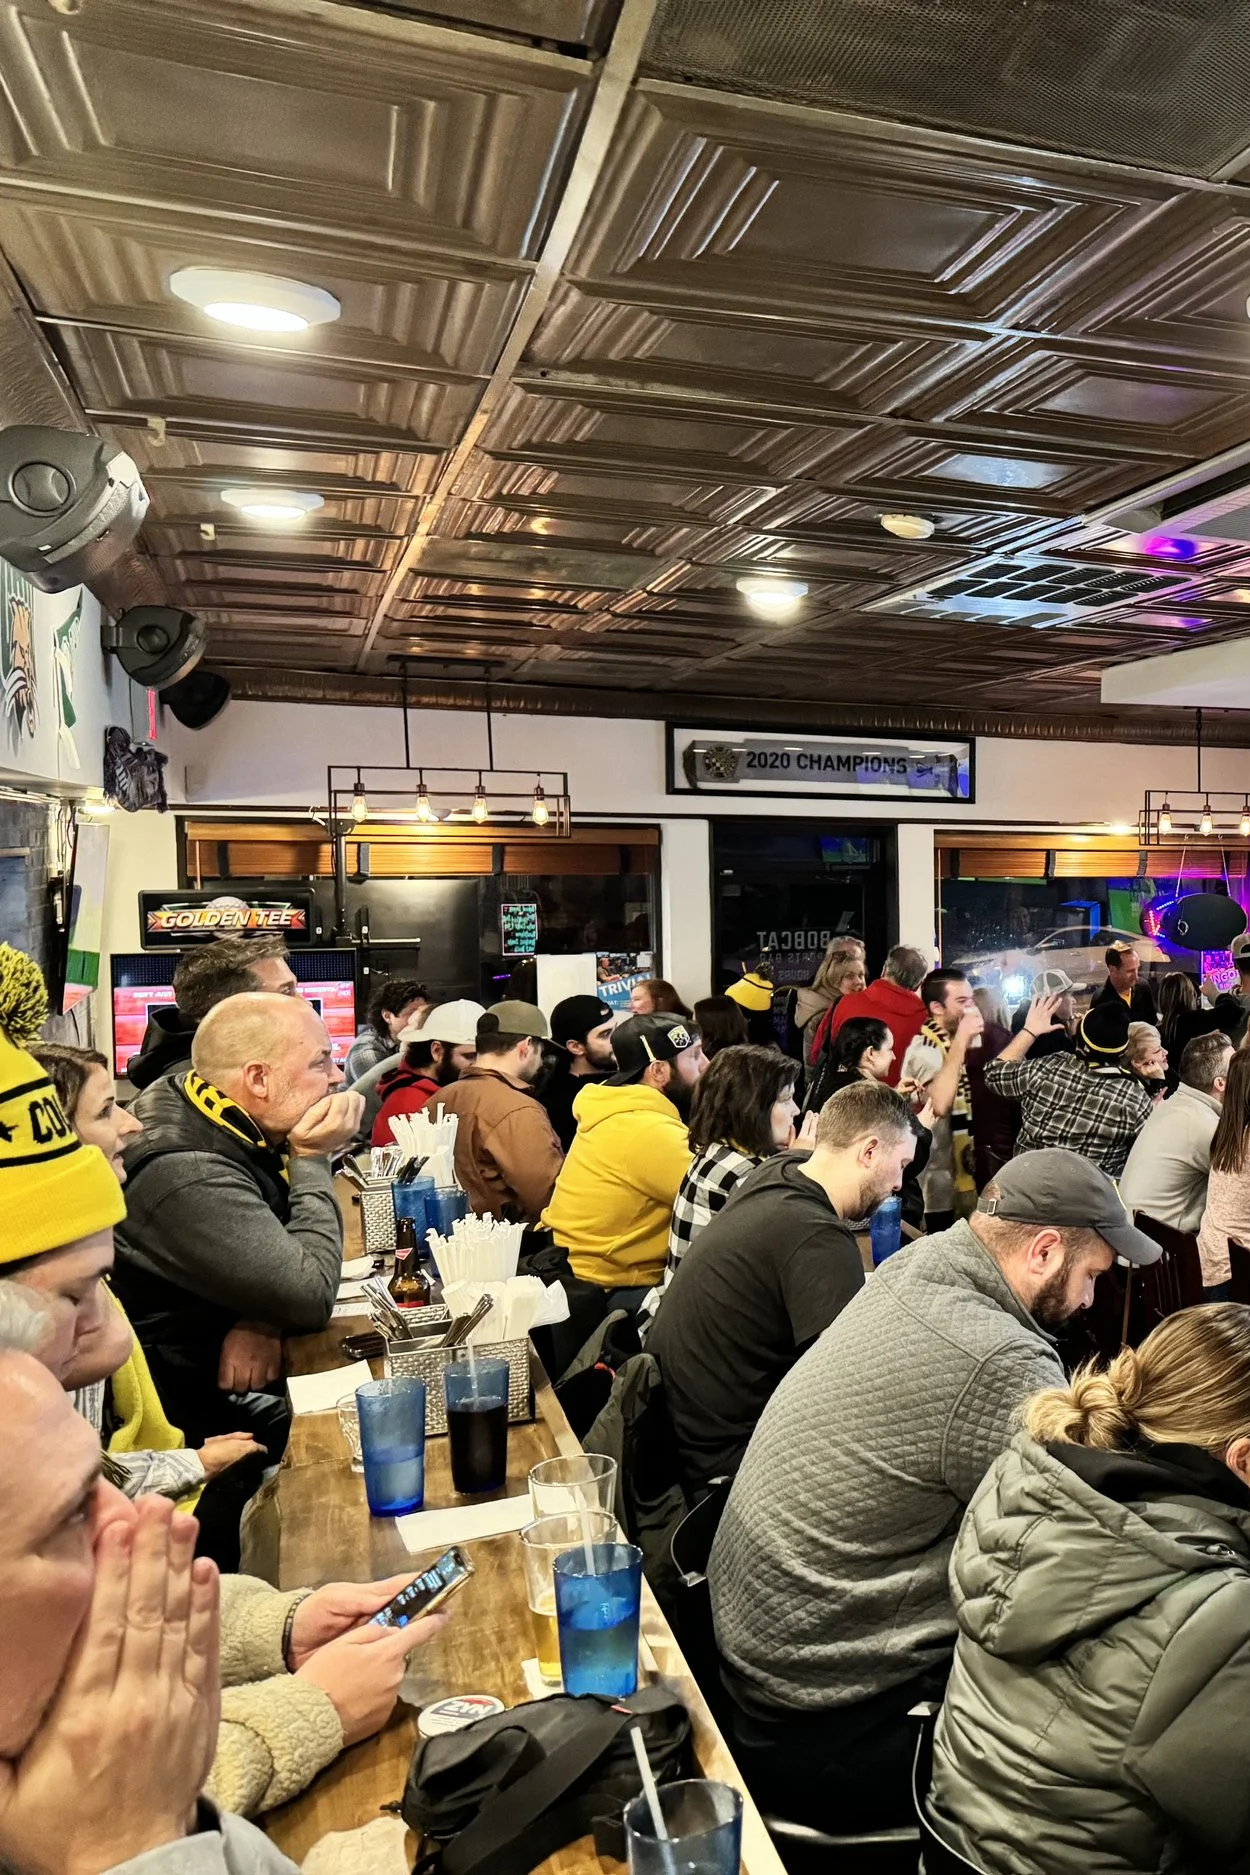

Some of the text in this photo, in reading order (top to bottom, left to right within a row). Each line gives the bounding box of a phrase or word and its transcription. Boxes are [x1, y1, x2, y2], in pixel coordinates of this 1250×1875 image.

[745, 751, 907, 774] 2020 CHAMPIONS
[160, 910, 293, 928] GOLDEN TEE
